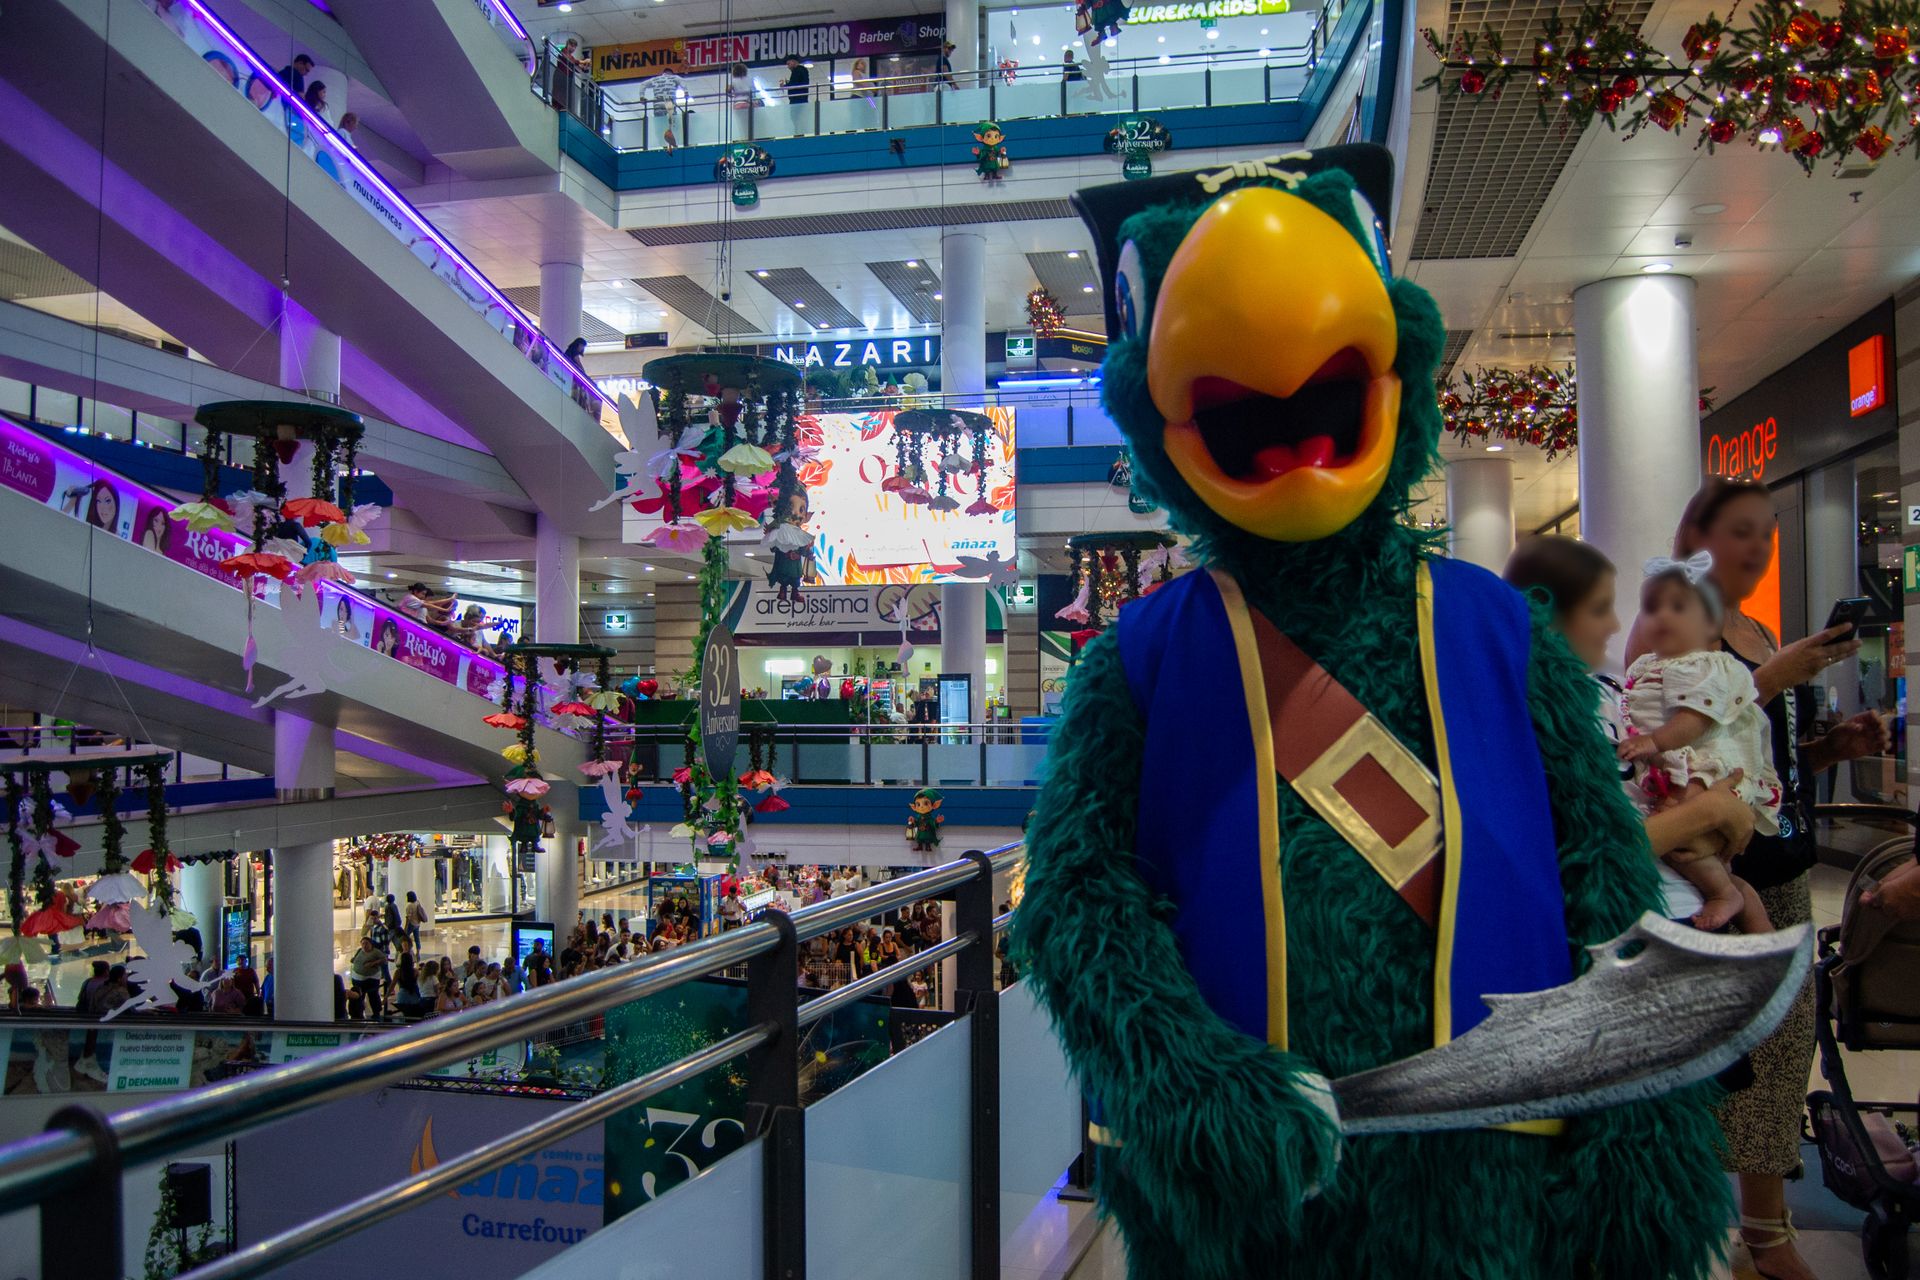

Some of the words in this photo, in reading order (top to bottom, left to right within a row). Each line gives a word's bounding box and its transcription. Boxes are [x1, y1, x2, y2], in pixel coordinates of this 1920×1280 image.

[600, 49, 682, 71] INFANTIL
[686, 36, 749, 67] THEN
[750, 24, 850, 62] PELUQUEROS
[859, 30, 895, 44] Barber
[918, 26, 947, 41] Shop
[1125, 120, 1150, 140] 32
[733, 147, 757, 167] 32
[1112, 139, 1163, 151] Aniversario
[776, 340, 930, 368] NAZARI
[1851, 390, 1875, 411] orange
[1708, 416, 1777, 480] Orange
[756, 594, 869, 618] arepissima
[787, 616, 816, 628] snack
[819, 614, 836, 627] bar
[404, 630, 447, 666] Ricky's
[709, 643, 730, 708] 32
[705, 710, 739, 735] Aniversario
[288, 1036, 313, 1045] NUEVA
[314, 1036, 338, 1045] TIENDA
[128, 1077, 179, 1087] DEICHMANN
[462, 1212, 588, 1245] Carrefour
